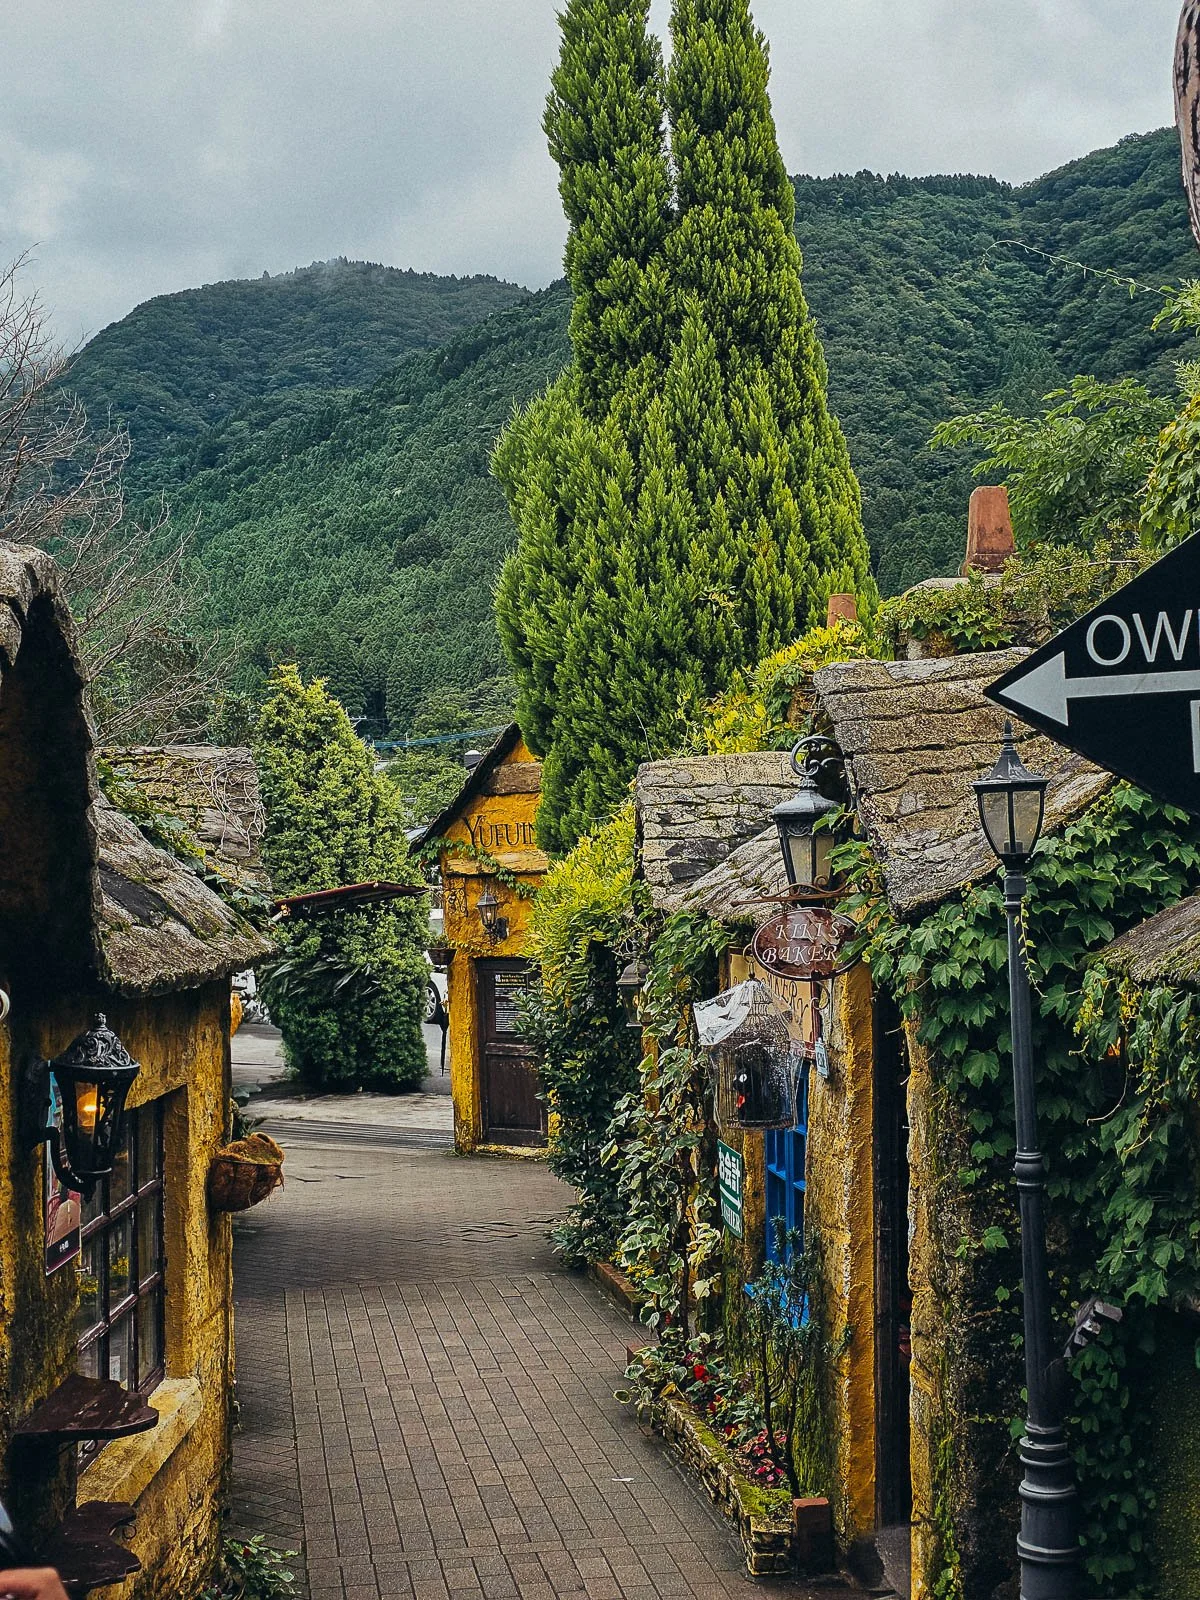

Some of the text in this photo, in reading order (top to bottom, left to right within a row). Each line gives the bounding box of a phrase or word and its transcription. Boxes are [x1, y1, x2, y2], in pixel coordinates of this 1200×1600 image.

[1086, 608, 1200, 666] OW
[775, 920, 841, 943] KIKI'S
[762, 945, 844, 965] BAKER
[718, 1147, 741, 1194] お会計
